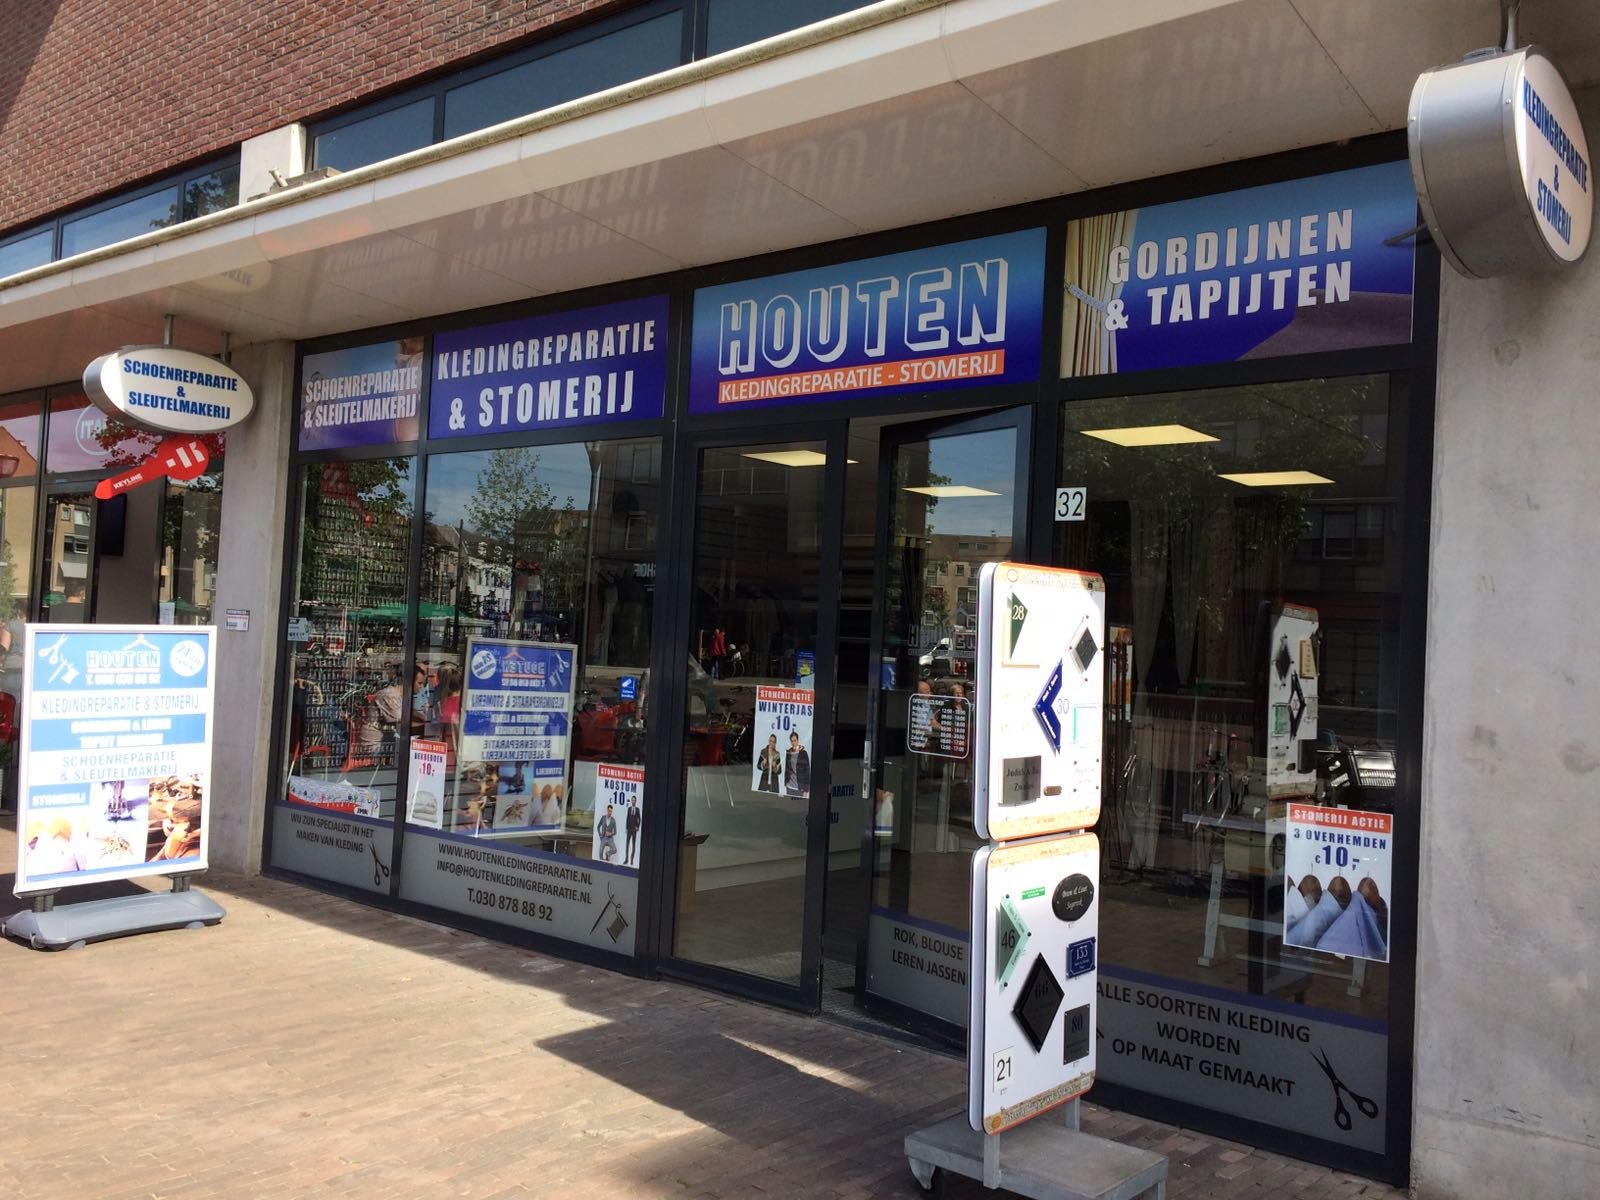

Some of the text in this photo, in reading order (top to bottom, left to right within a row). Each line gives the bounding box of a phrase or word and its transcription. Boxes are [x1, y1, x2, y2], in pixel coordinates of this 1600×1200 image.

[1523, 76, 1588, 193] KLEDINGREPARATIE
[1553, 164, 1560, 193] &
[1537, 178, 1572, 246] STOMERIJ
[1108, 208, 1353, 285] GORDIJNEN
[1105, 261, 1352, 332] & TAPIJTEN
[718, 257, 1009, 376] HOUTEN
[438, 320, 656, 381] KLEDINGREPARATIE
[124, 358, 238, 392] SCHOENREPARATIE
[305, 366, 418, 403] SCHOENREPARATIE
[720, 366, 883, 402] KLEDINGREPARATIE
[899, 354, 998, 384] STOMERIJ
[128, 391, 231, 420] SLEUTELMAKERIJ
[176, 386, 186, 398] &
[448, 370, 635, 432] & STOMERIJ
[304, 393, 416, 429] & SLEUTELMAKERIJ
[113, 473, 143, 489] KEYLINE
[1058, 491, 1083, 517] 32
[1012, 604, 1024, 621] 28
[42, 696, 140, 714] KLEDINGREPARATIE
[154, 694, 200, 711] STOMERIJ
[758, 701, 813, 716] WINTERJAS
[1056, 698, 1070, 714] 30
[60, 764, 178, 782] & SLEUTELMAKERIJ
[62, 750, 176, 768] SCHOENREPARATIE
[604, 778, 637, 792] KOSTUM
[290, 812, 375, 838] WIJ ZIJN SPECIALIST IN HET
[1294, 810, 1385, 830] STOMERIJ ACTIE
[296, 830, 364, 853] MAKEN VAN KLEDING
[1294, 828, 1386, 850] 3 OVERHEMDEN
[438, 842, 592, 886] WWW.HOUTENKLEDINGREPARATIE.NL
[436, 860, 592, 904] INFO@HOUTENKLEDINGREPARATIE.NL
[467, 887, 553, 921] T.030 878 88 92
[894, 927, 963, 960] ROK, BLOUSE
[1001, 930, 1016, 948] 46
[892, 949, 966, 986] LEREN JASSEN
[1072, 1014, 1083, 1034] 80
[1096, 982, 1311, 1043] ALLE SOORTEN KLEDING
[1156, 1021, 1241, 1056] WORDEN
[996, 1056, 1012, 1082] 21
[1112, 1038, 1296, 1098] OP MAAT GEMAAKT
